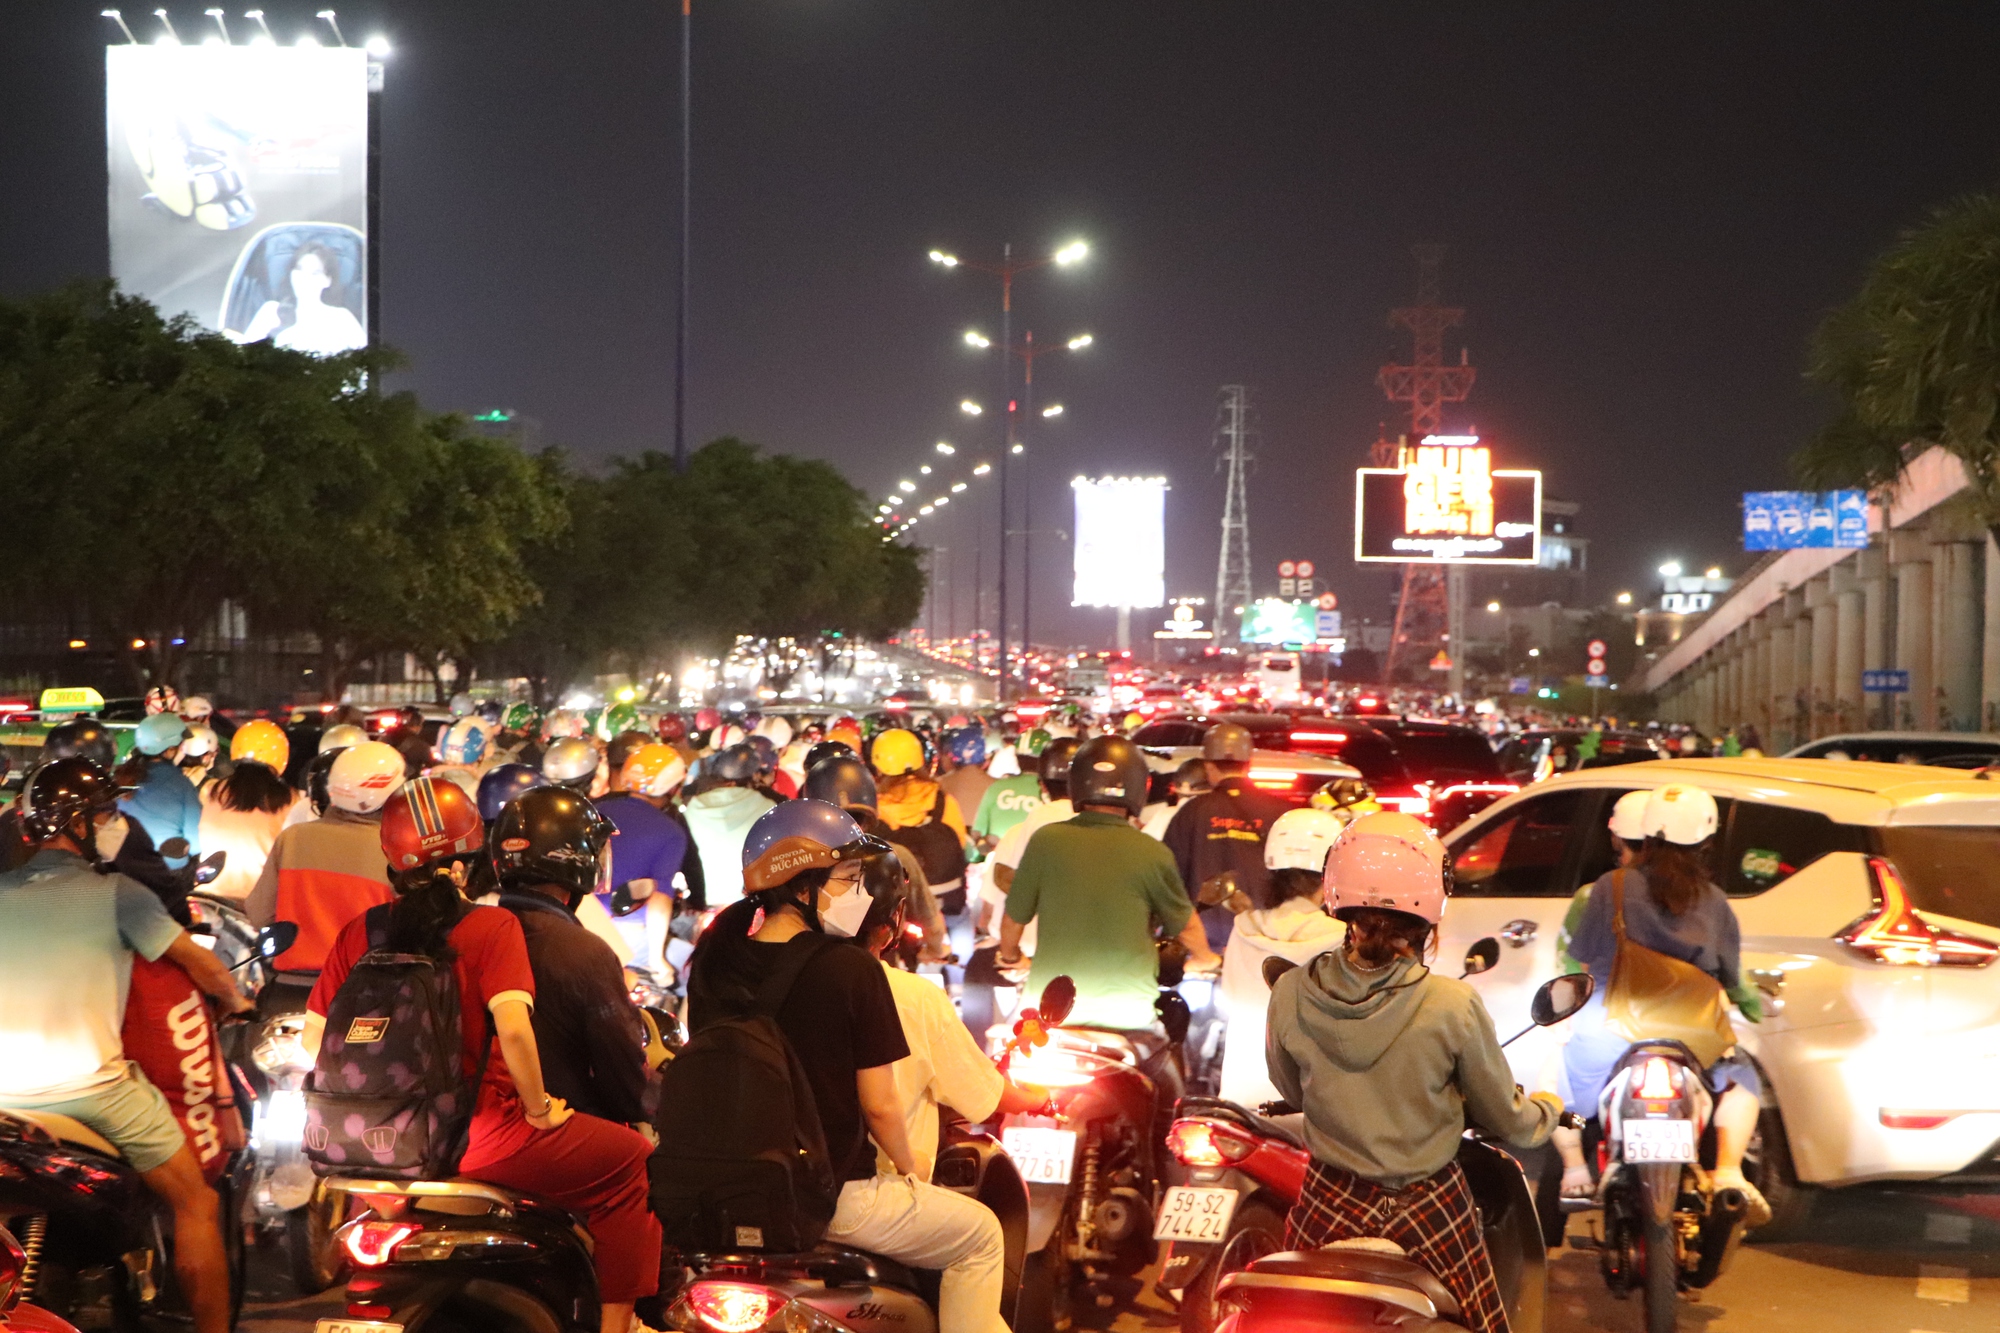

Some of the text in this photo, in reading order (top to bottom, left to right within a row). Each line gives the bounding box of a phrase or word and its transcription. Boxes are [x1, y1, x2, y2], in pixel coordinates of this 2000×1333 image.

[997, 789, 1042, 813] Gra
[771, 848, 806, 862] HONDA
[167, 989, 221, 1164] Wilson
[1012, 1156, 1066, 1179] 77.61
[1173, 1192, 1225, 1215] 59-S2
[1159, 1214, 1222, 1239] 744.24
